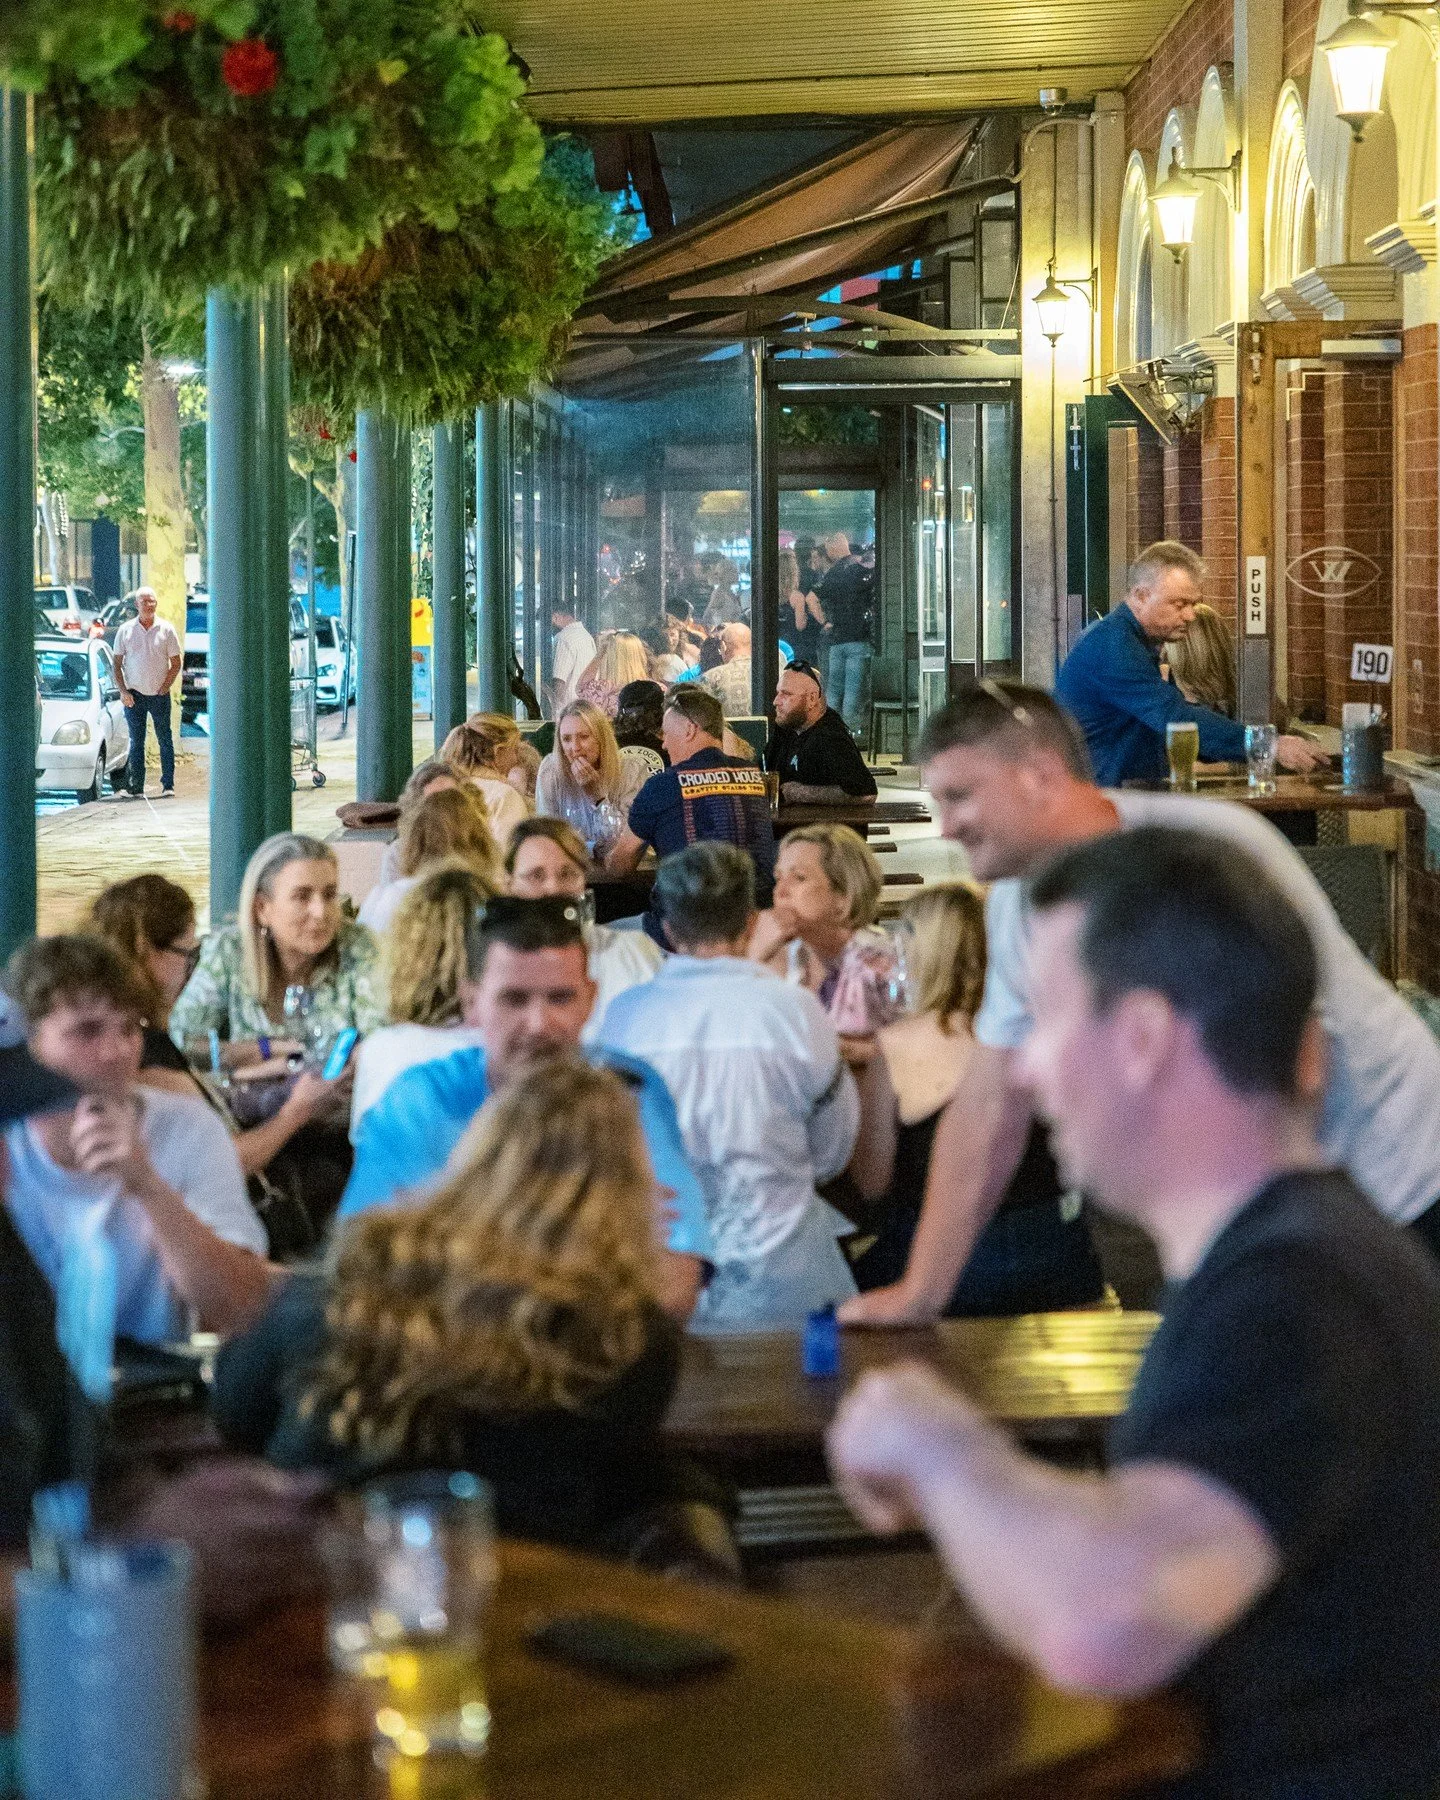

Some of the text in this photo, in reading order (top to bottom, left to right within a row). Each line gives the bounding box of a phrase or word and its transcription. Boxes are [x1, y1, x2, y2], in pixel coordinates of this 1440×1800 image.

[1251, 569, 1261, 622] PUSH
[1356, 650, 1389, 676] 190
[678, 771, 730, 786] CROWDED
